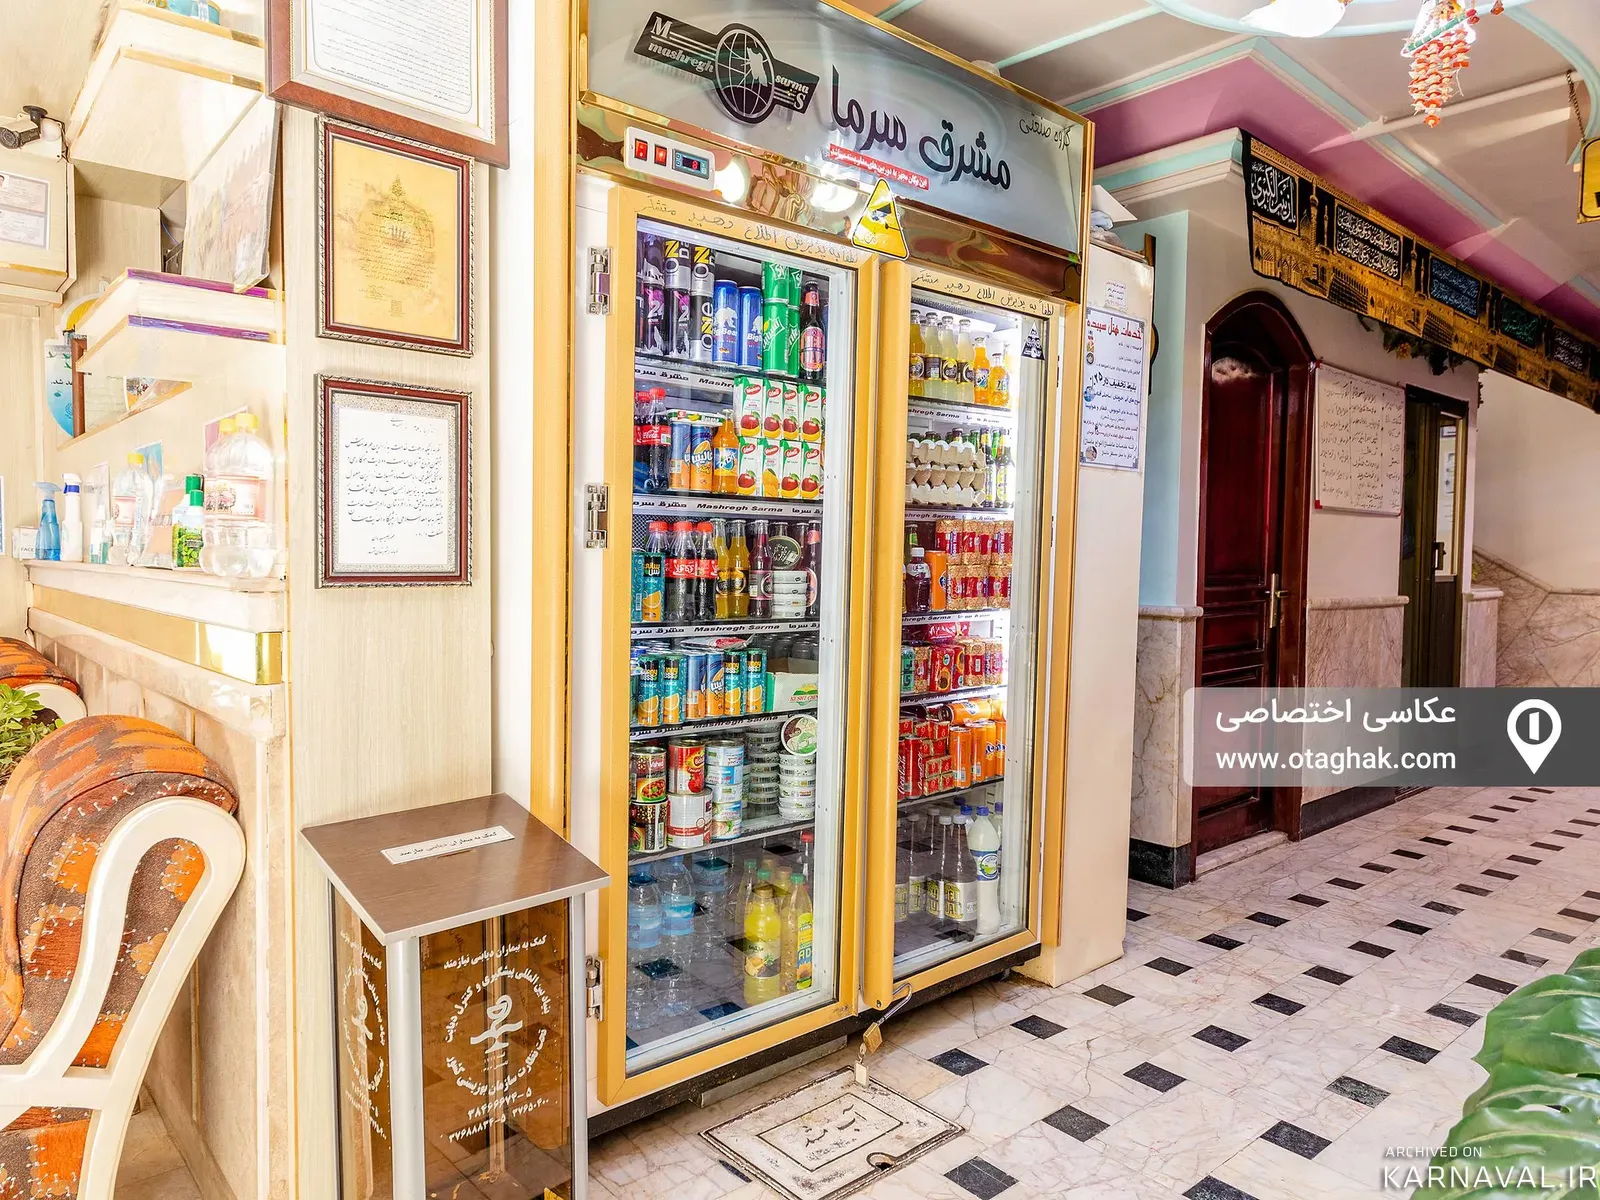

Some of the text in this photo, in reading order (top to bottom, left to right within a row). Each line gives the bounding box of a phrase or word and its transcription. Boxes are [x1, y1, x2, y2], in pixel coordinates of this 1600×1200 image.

[651, 16, 672, 39] M
[648, 42, 714, 73] mashregh
[774, 74, 809, 94] sarma
[832, 64, 1011, 190] مشرق سرما
[1019, 112, 1075, 151] گروه صنعتی
[688, 212, 734, 229] دهید
[744, 224, 777, 243] اطلاع
[944, 282, 971, 293] دهید
[977, 287, 996, 299] اطلاع
[936, 411, 960, 419] Sarma
[696, 502, 783, 513] Mashregh Sarma
[693, 625, 746, 633] Mashregh
[450, 837, 473, 847] بیماران
[481, 831, 497, 839] کمک
[400, 848, 424, 857] نیازمند
[443, 935, 547, 969] کمک به بیماران دیابتی نیازمند
[481, 965, 516, 987] پیشگیری
[514, 967, 540, 985] المللی
[475, 983, 482, 993] و
[533, 983, 546, 998] بین
[454, 985, 473, 1015] کنترل
[517, 1049, 539, 1078] نظارت
[488, 1075, 518, 1095] سازمان
